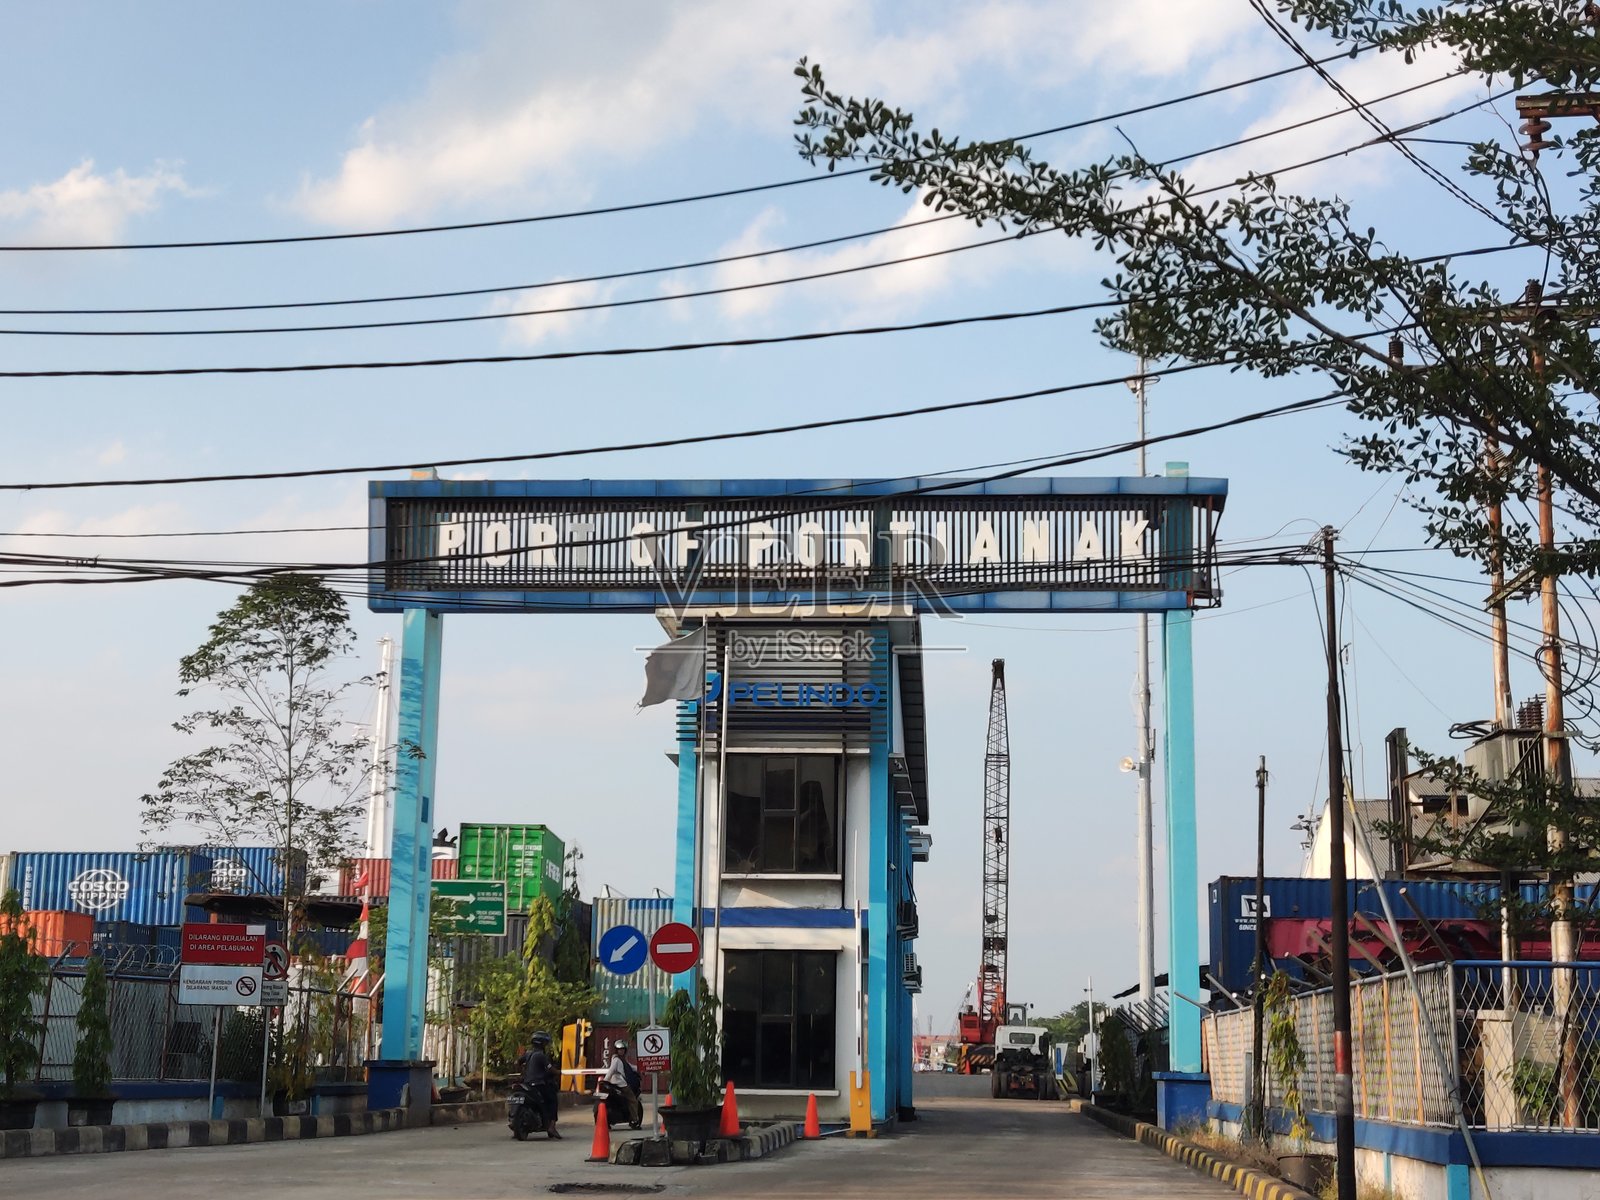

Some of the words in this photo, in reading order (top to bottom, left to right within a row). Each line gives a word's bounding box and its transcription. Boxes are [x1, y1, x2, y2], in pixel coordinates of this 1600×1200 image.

[438, 521, 594, 568] PORT
[631, 521, 702, 567] OF
[749, 520, 1149, 568] PONTIANAK
[729, 682, 881, 707] PELINDO
[68, 881, 130, 892] COSCO
[70, 892, 127, 900] SHIPPING
[188, 934, 221, 942] DILARANG
